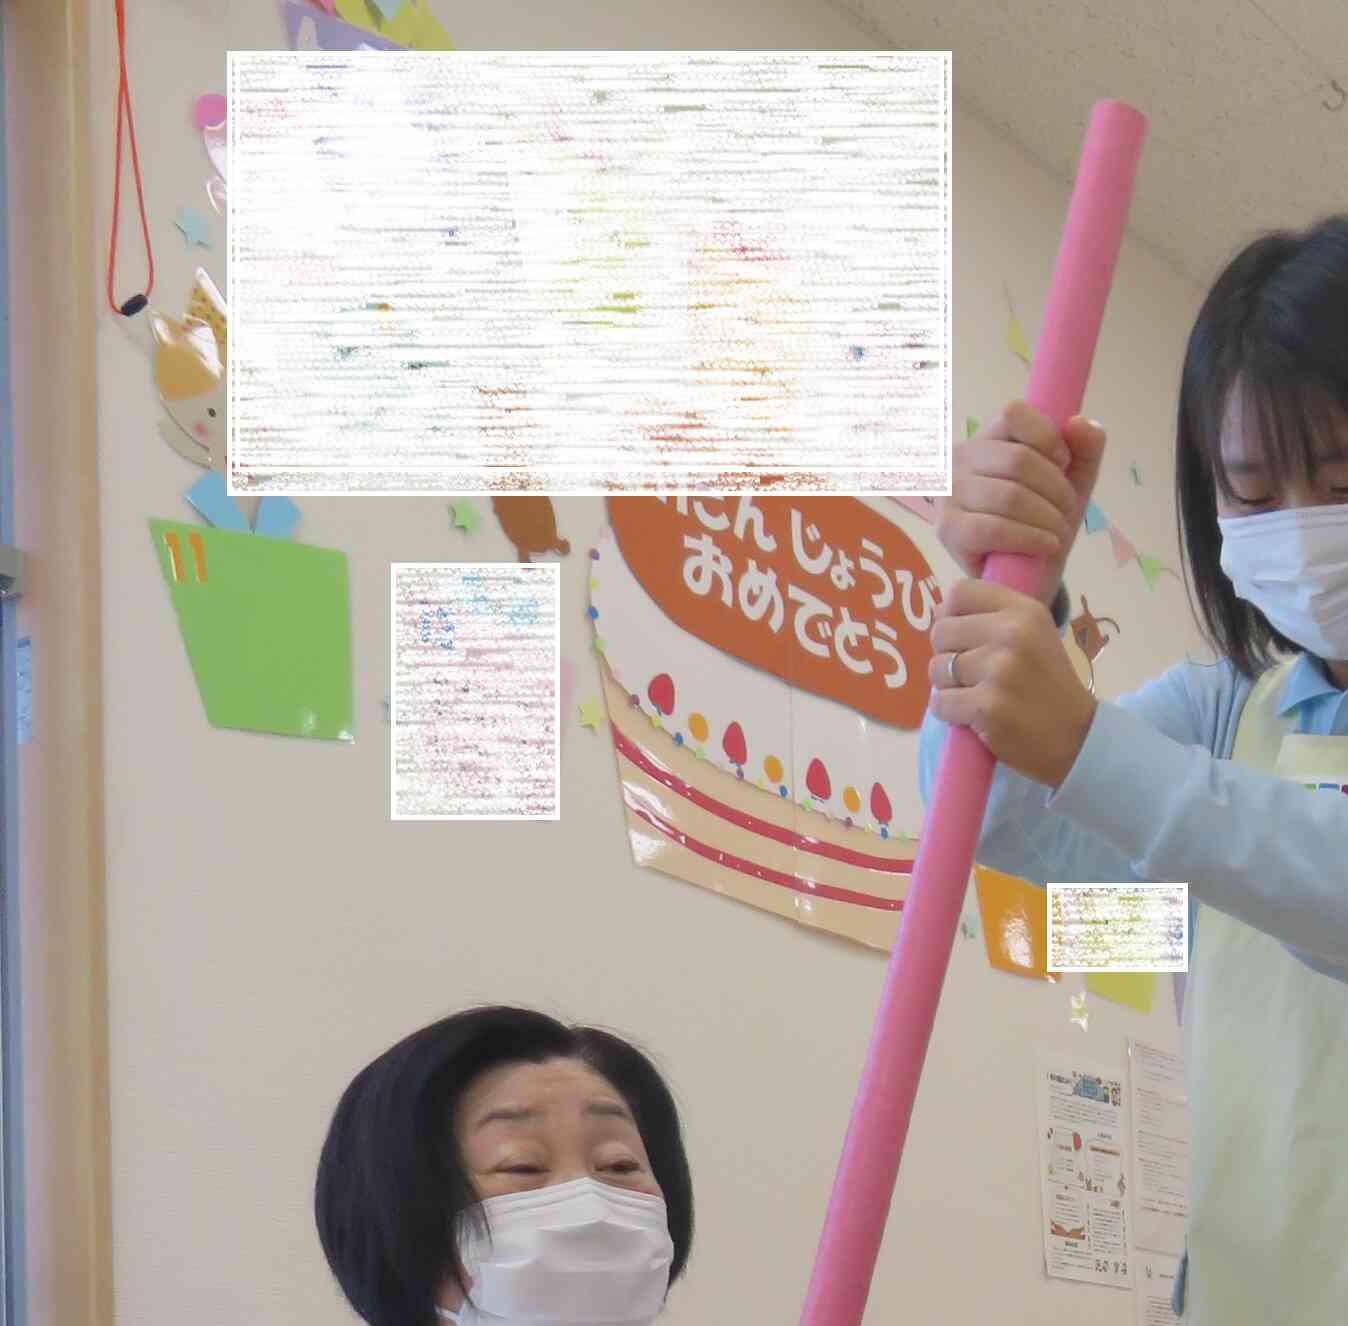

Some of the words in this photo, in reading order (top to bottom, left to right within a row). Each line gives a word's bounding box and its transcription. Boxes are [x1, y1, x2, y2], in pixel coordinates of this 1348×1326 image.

[682, 533, 908, 689] おめでとう
